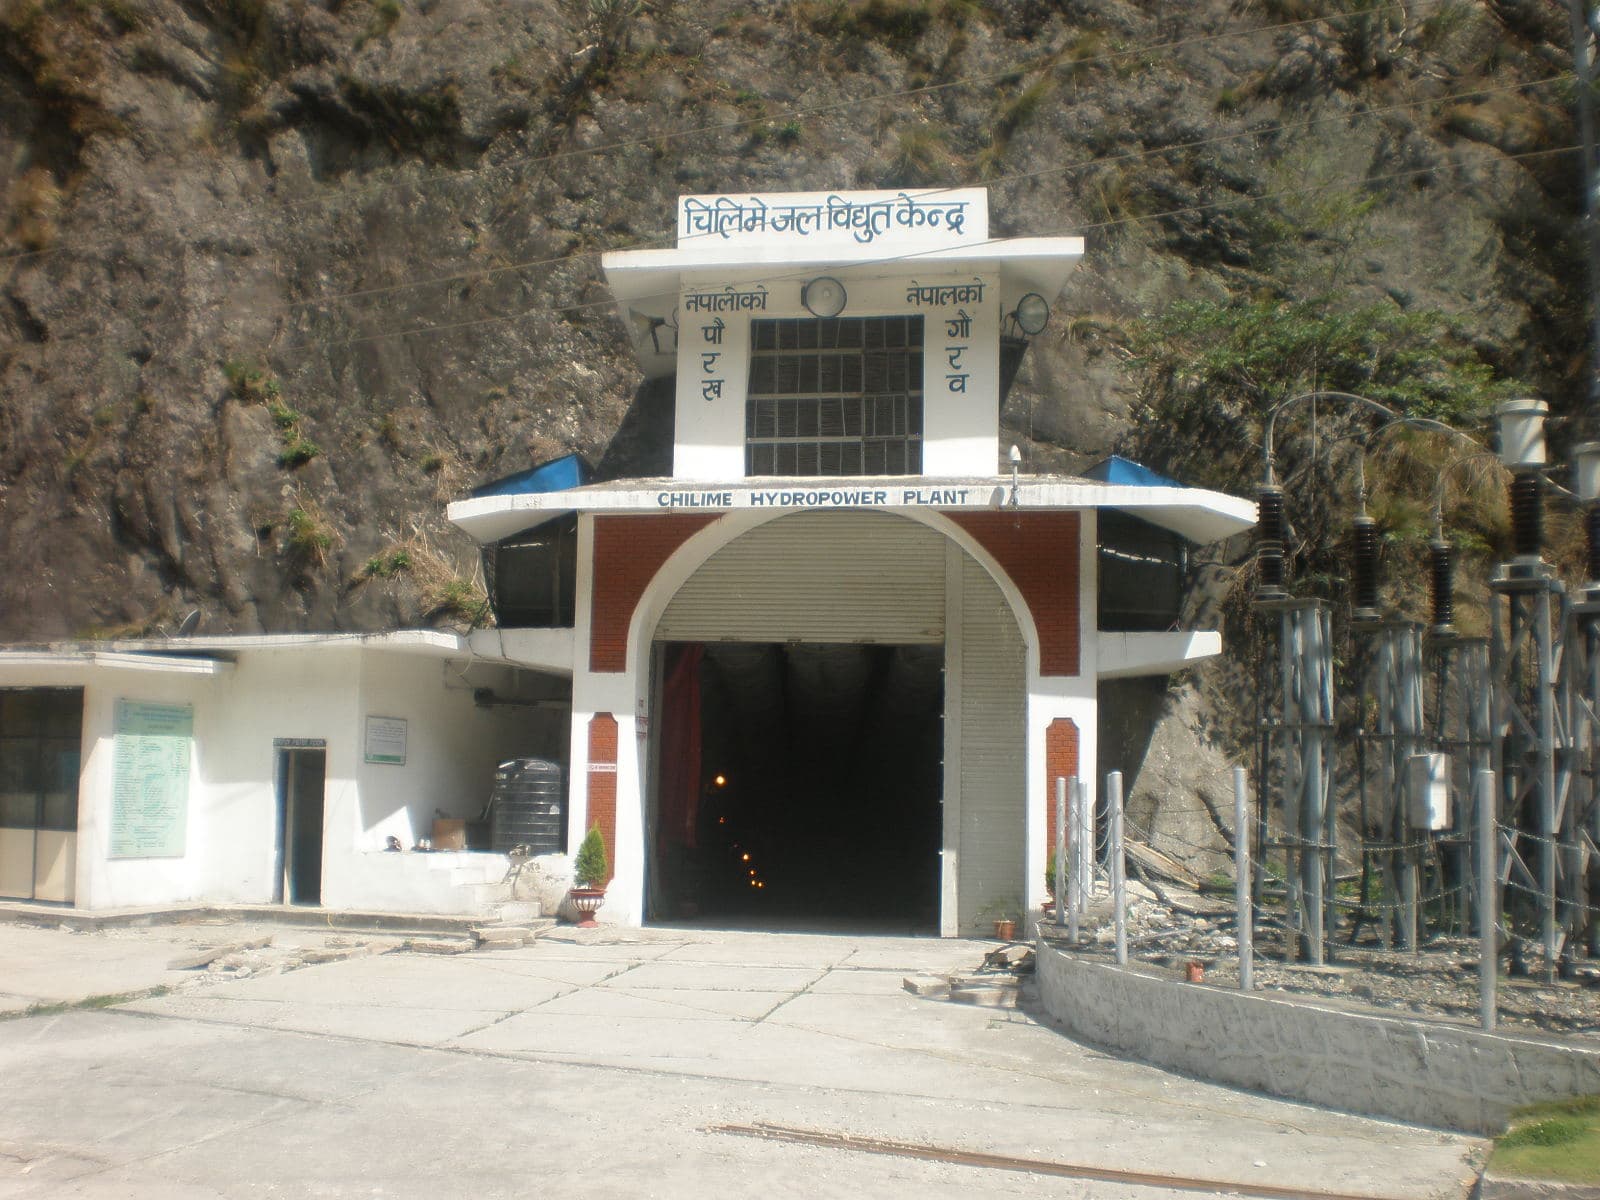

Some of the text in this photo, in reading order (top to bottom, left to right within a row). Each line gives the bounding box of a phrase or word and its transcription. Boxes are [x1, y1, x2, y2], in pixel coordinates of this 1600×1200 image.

[684, 192, 970, 243] चिलिमे जल विद्युत केन्द्र
[906, 277, 987, 306] नेपालको
[657, 489, 969, 506] CHILIME HYDROPOWER PLANT
